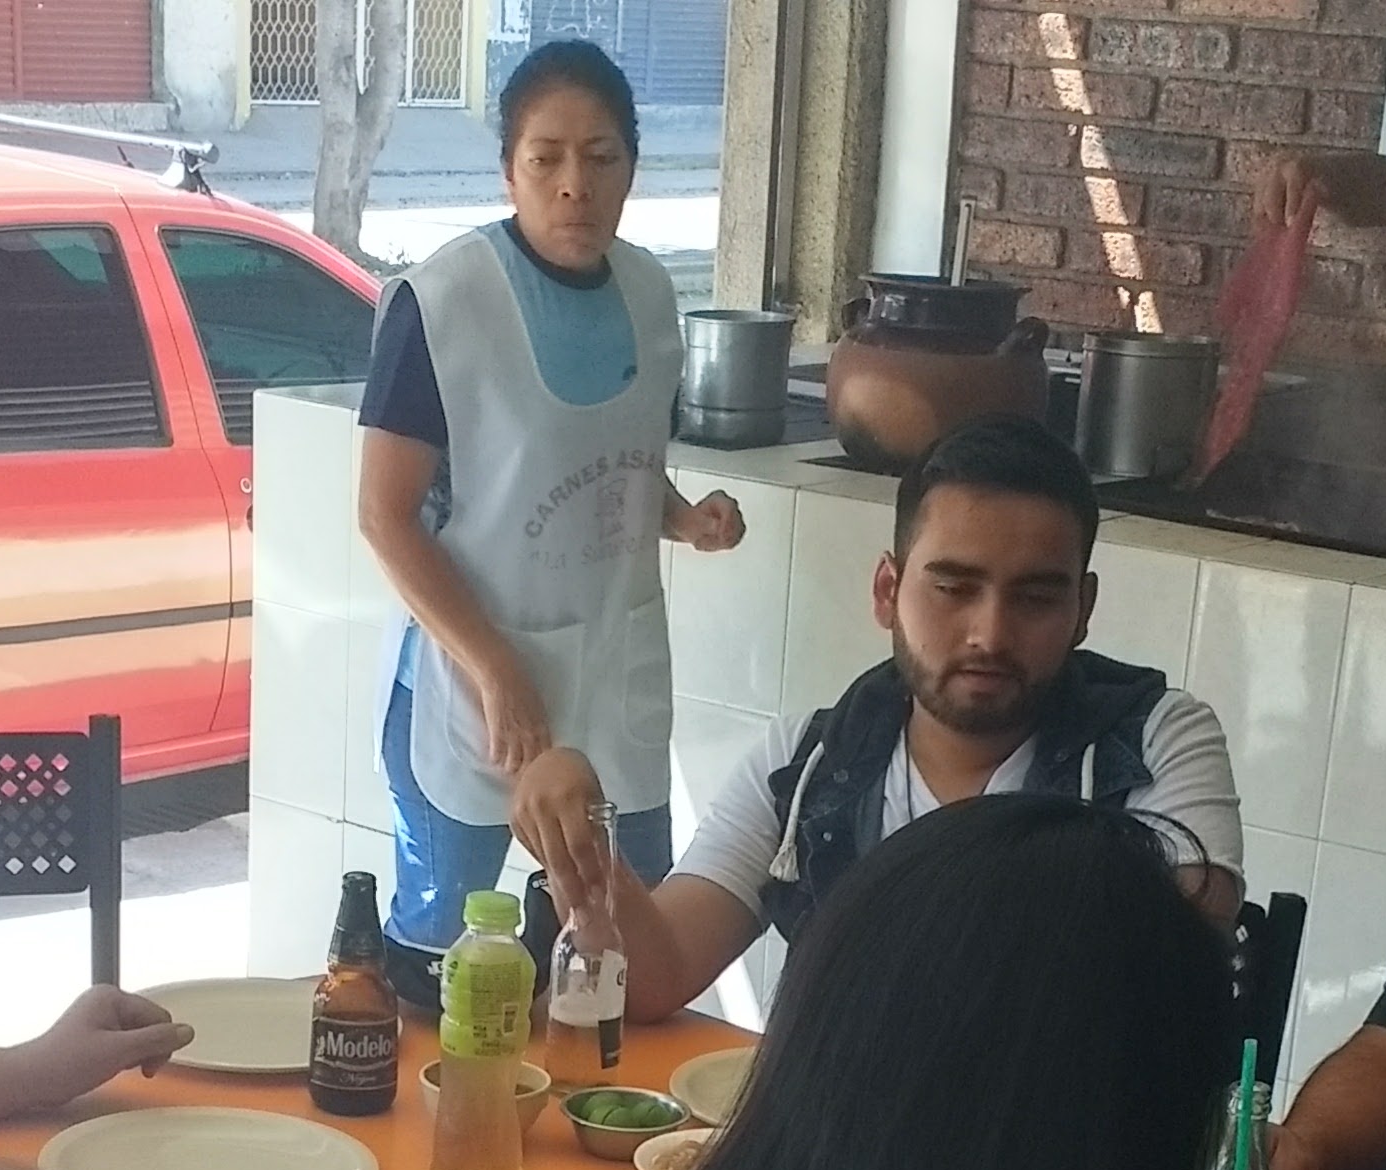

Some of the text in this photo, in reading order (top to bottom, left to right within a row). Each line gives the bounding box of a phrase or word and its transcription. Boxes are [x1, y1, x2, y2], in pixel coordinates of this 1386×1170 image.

[524, 449, 664, 539] CARNES ASA
[327, 1030, 391, 1058] Modelo
